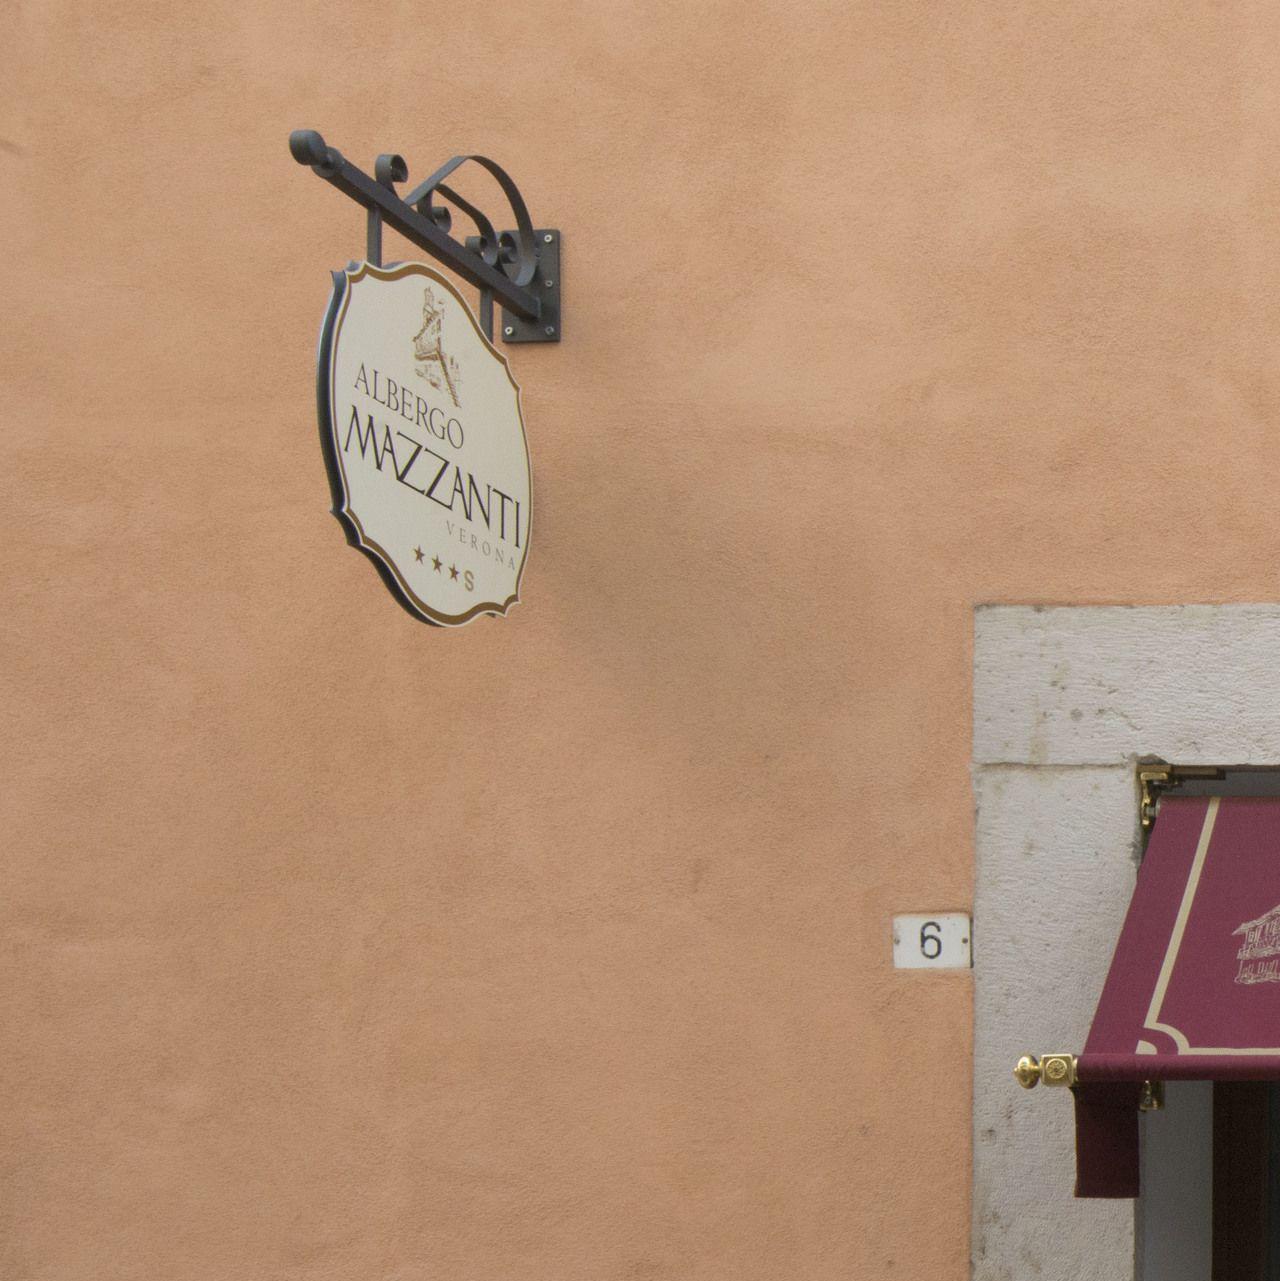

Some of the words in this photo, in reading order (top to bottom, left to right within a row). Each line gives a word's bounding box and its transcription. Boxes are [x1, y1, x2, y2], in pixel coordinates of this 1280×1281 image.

[355, 363, 464, 449] ALBERGO
[344, 405, 520, 548] MAZZANTI
[446, 520, 515, 571] VERONA
[921, 921, 942, 959] 6
